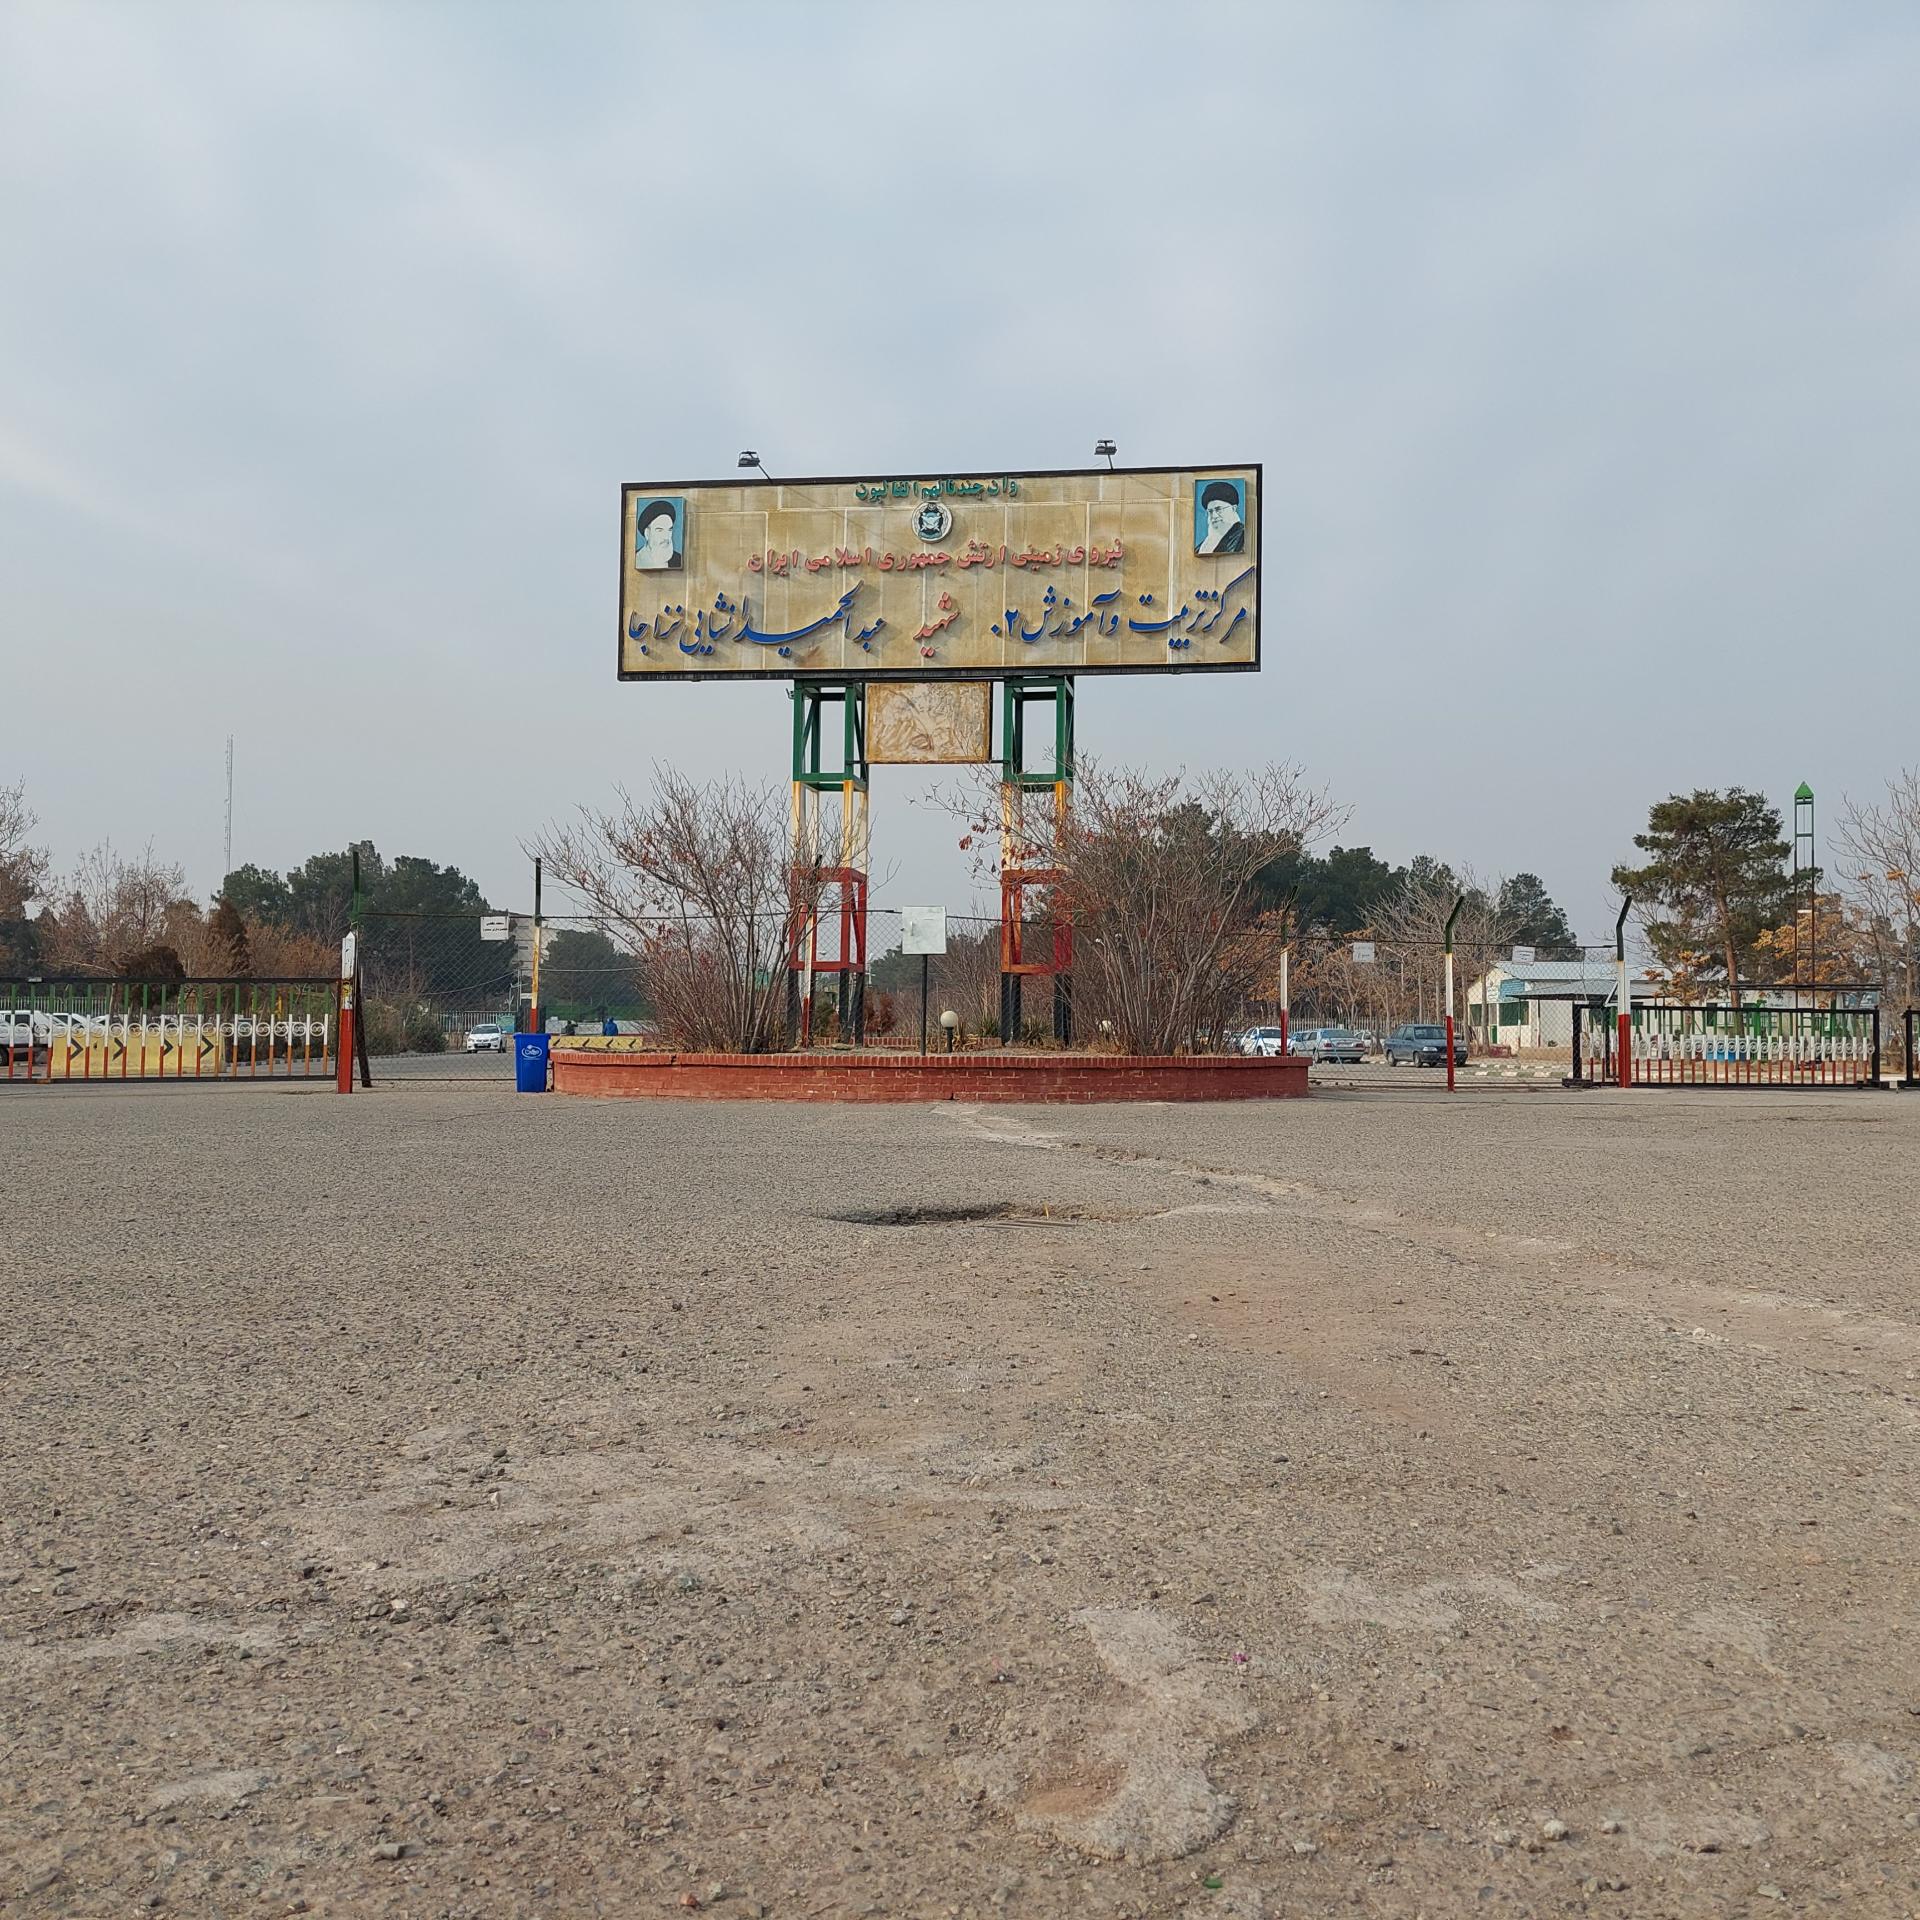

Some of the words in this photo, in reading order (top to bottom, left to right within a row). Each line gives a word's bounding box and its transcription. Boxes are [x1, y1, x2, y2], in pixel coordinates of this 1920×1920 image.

[746, 547, 800, 577] ایران
[804, 545, 872, 572] اسلامی
[877, 550, 952, 577] جمهوری
[956, 539, 1007, 568] ارتش
[1010, 543, 1063, 572] زمینی
[1066, 538, 1125, 568] نیروی
[1203, 565, 1256, 644] مرکز
[913, 591, 961, 658] شهید
